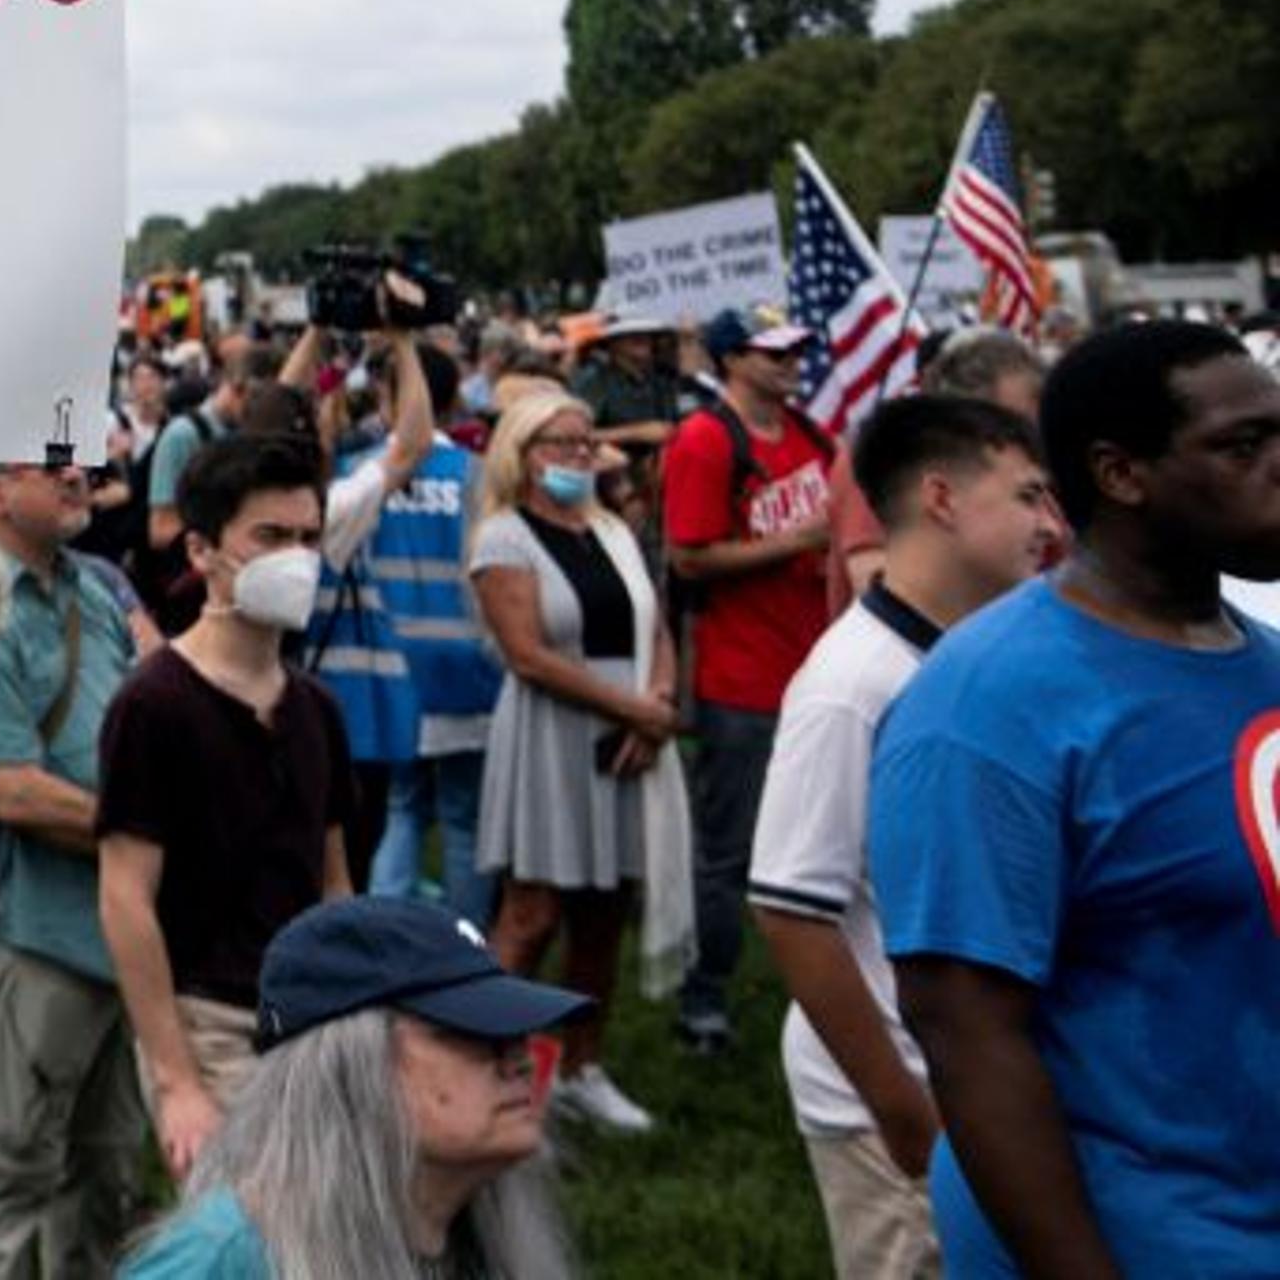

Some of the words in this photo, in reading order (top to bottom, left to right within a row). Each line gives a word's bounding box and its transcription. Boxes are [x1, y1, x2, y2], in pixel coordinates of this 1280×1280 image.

[611, 251, 646, 276] DO
[653, 241, 695, 266] THE
[704, 227, 774, 255] CRIME
[626, 277, 662, 302] DO
[667, 268, 709, 292] THE
[719, 255, 770, 281] TIME
